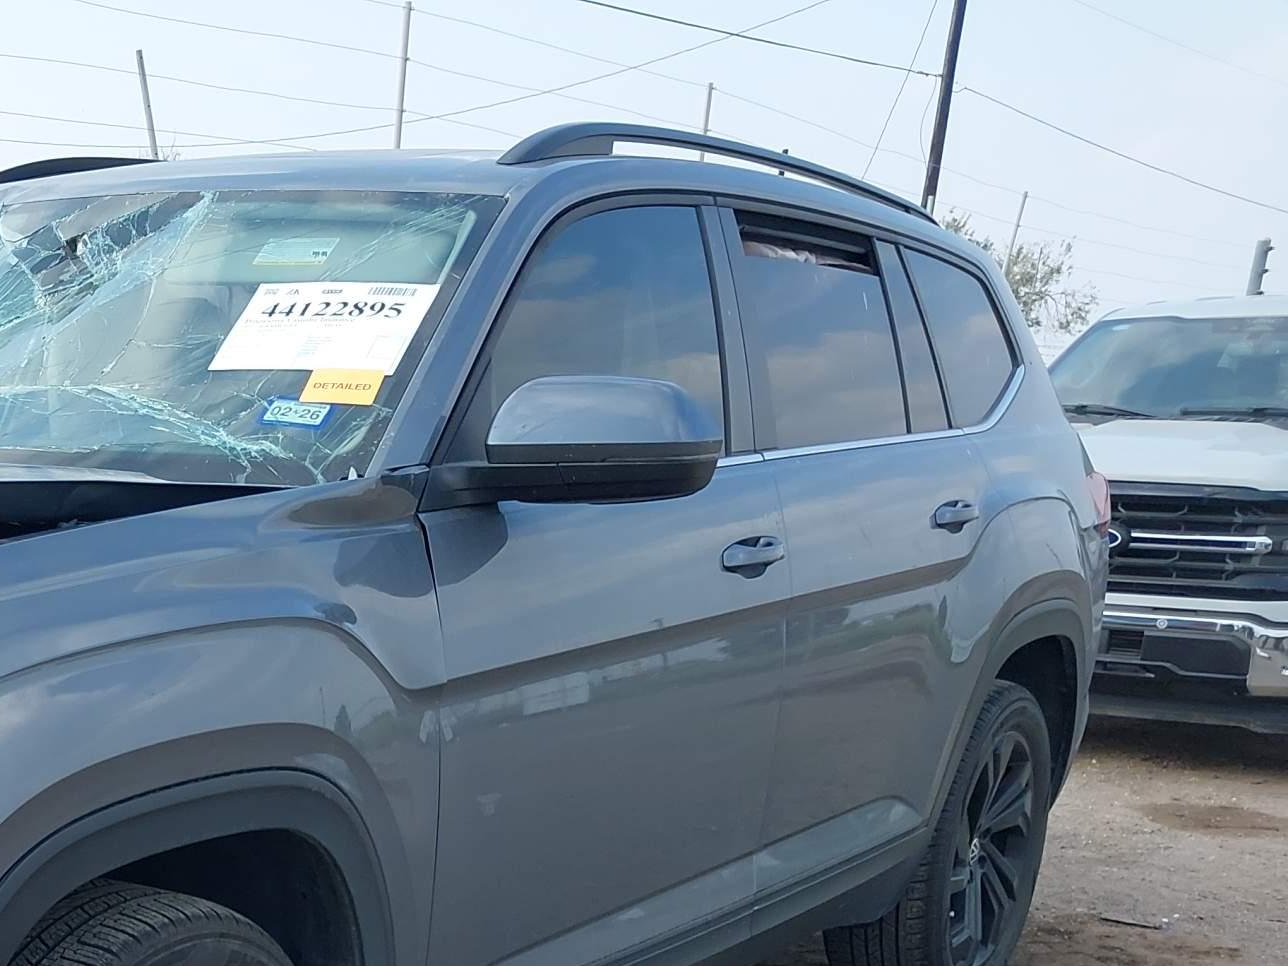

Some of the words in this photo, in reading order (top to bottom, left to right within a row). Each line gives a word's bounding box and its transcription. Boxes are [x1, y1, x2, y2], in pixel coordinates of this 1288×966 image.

[261, 301, 406, 318] 44122895
[312, 381, 373, 392] DETAILED
[269, 405, 293, 417] 02
[298, 407, 323, 421] 26
